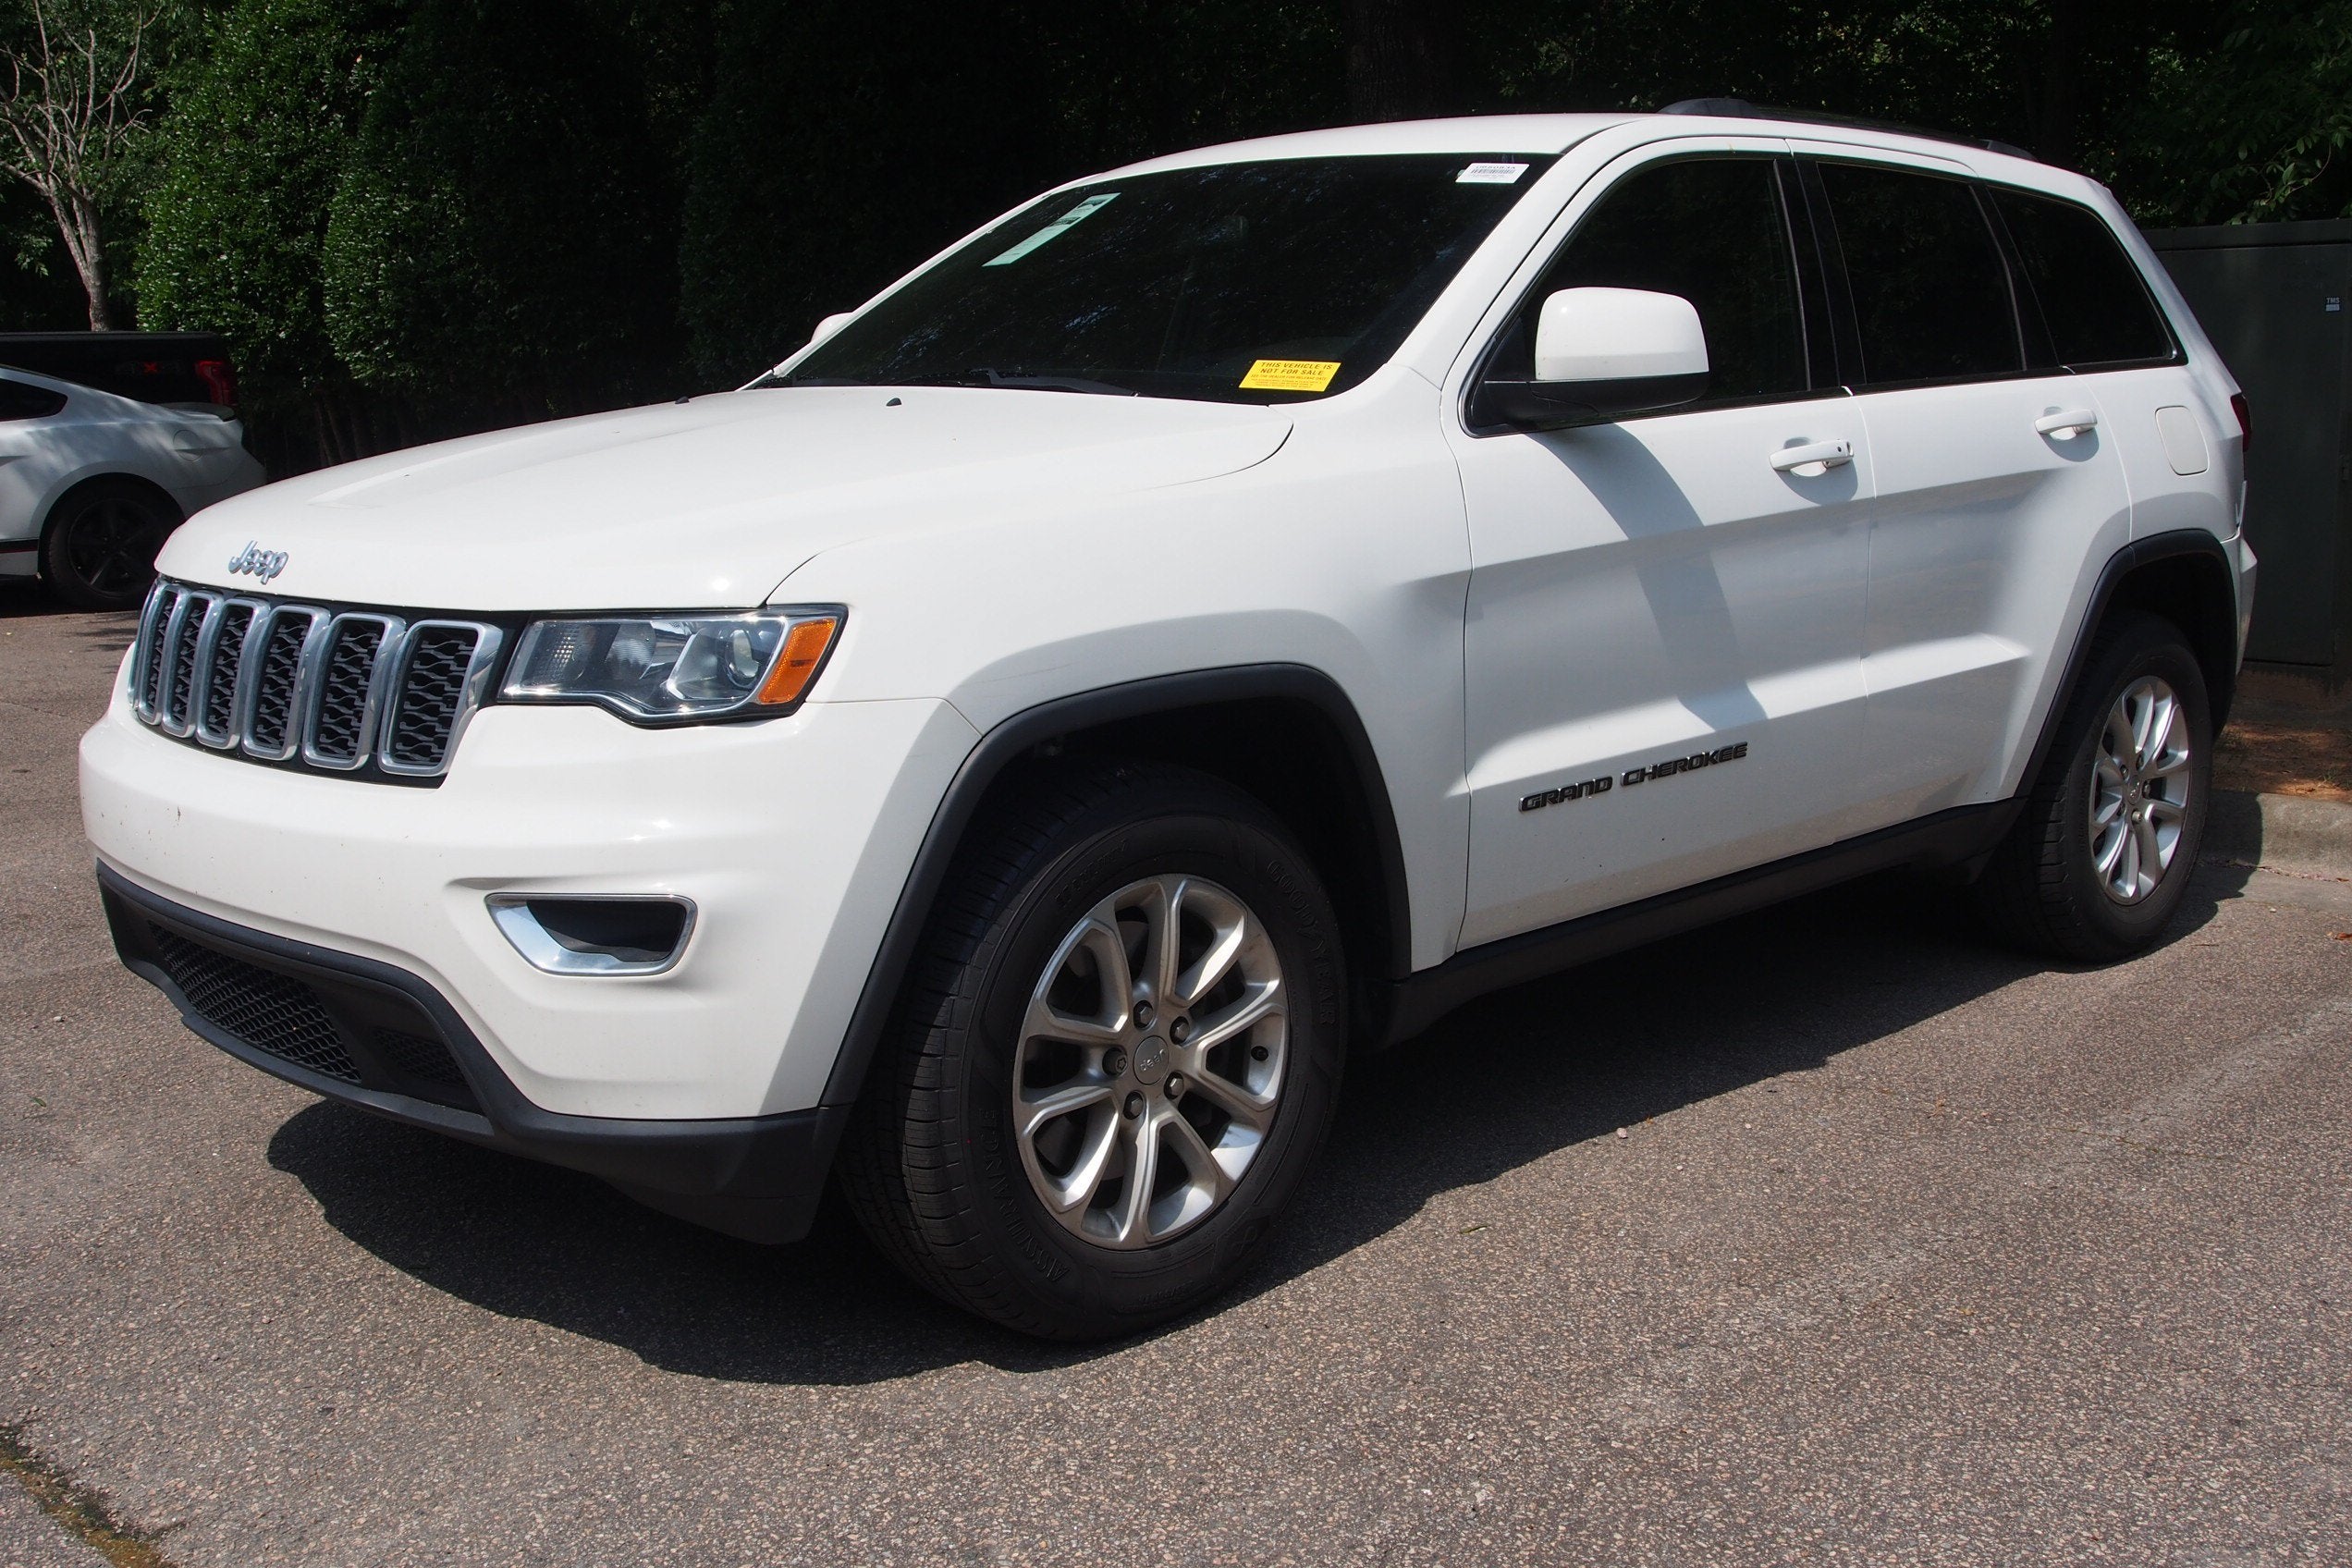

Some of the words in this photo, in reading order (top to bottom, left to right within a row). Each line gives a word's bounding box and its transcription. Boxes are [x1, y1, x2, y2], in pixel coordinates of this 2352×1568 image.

[228, 540, 288, 585] Jeep
[1518, 776, 1613, 812] GRAND
[1620, 741, 1748, 787] CHEROKEE
[1266, 859, 1337, 1026] GOODYEAR
